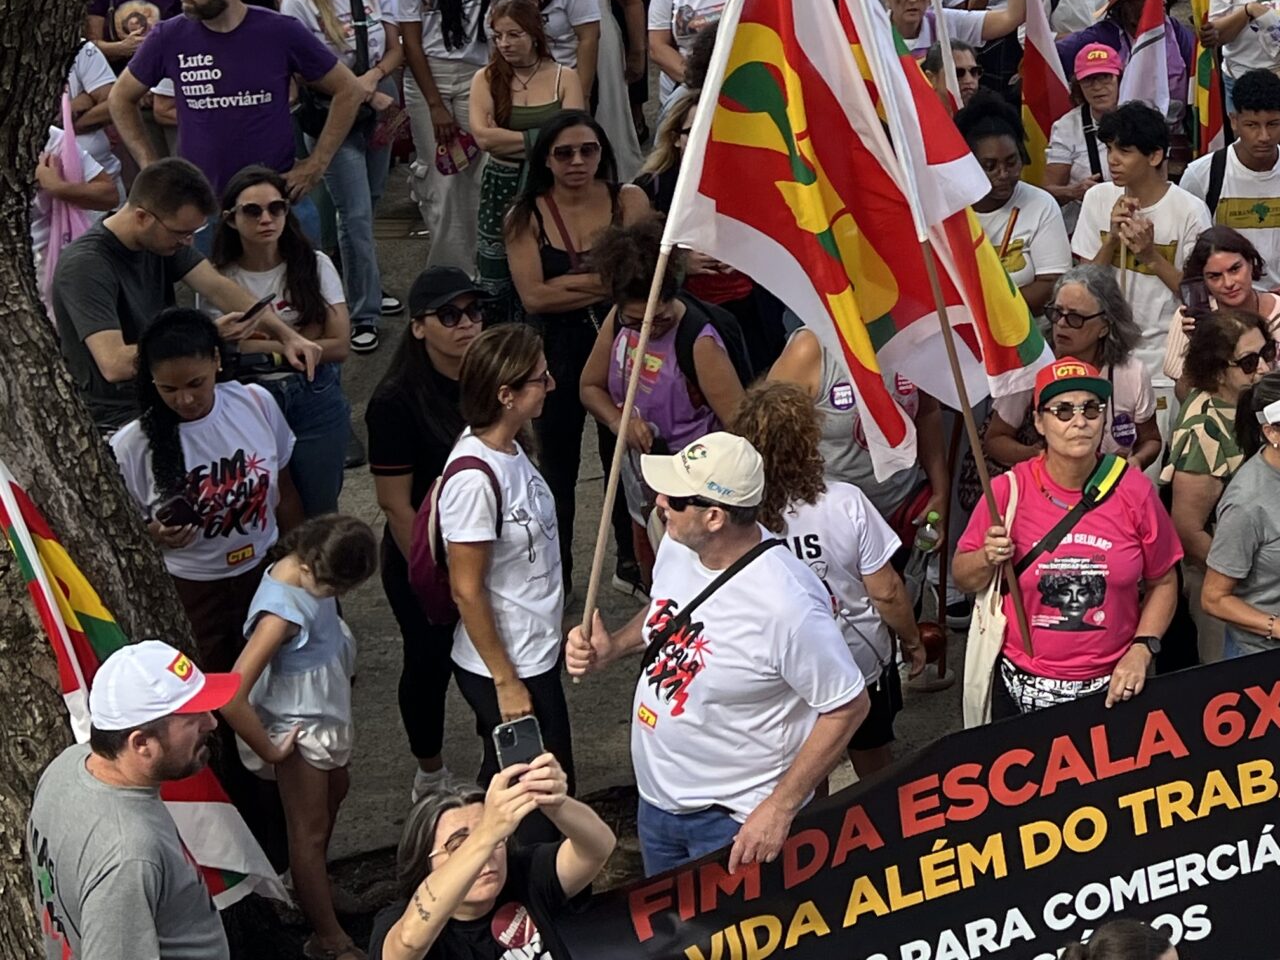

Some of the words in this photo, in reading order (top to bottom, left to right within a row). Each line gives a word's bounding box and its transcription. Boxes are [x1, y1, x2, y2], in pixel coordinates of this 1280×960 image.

[177, 53, 214, 69] Lute
[180, 68, 222, 83] como
[181, 83, 215, 96] uma
[186, 89, 273, 110] metroviária
[1055, 366, 1088, 378] CTB
[185, 448, 247, 497] FIM
[1074, 533, 1113, 551] CELULAR?
[228, 546, 253, 562] CTB
[638, 707, 657, 727] CTB
[629, 856, 762, 943] FIM
[783, 805, 885, 891] DA
[897, 709, 1190, 840] ESCALA
[684, 900, 832, 960] VIDA
[842, 832, 1009, 928] ALÉM
[1020, 806, 1109, 871] DO
[900, 907, 1037, 960] PARA
